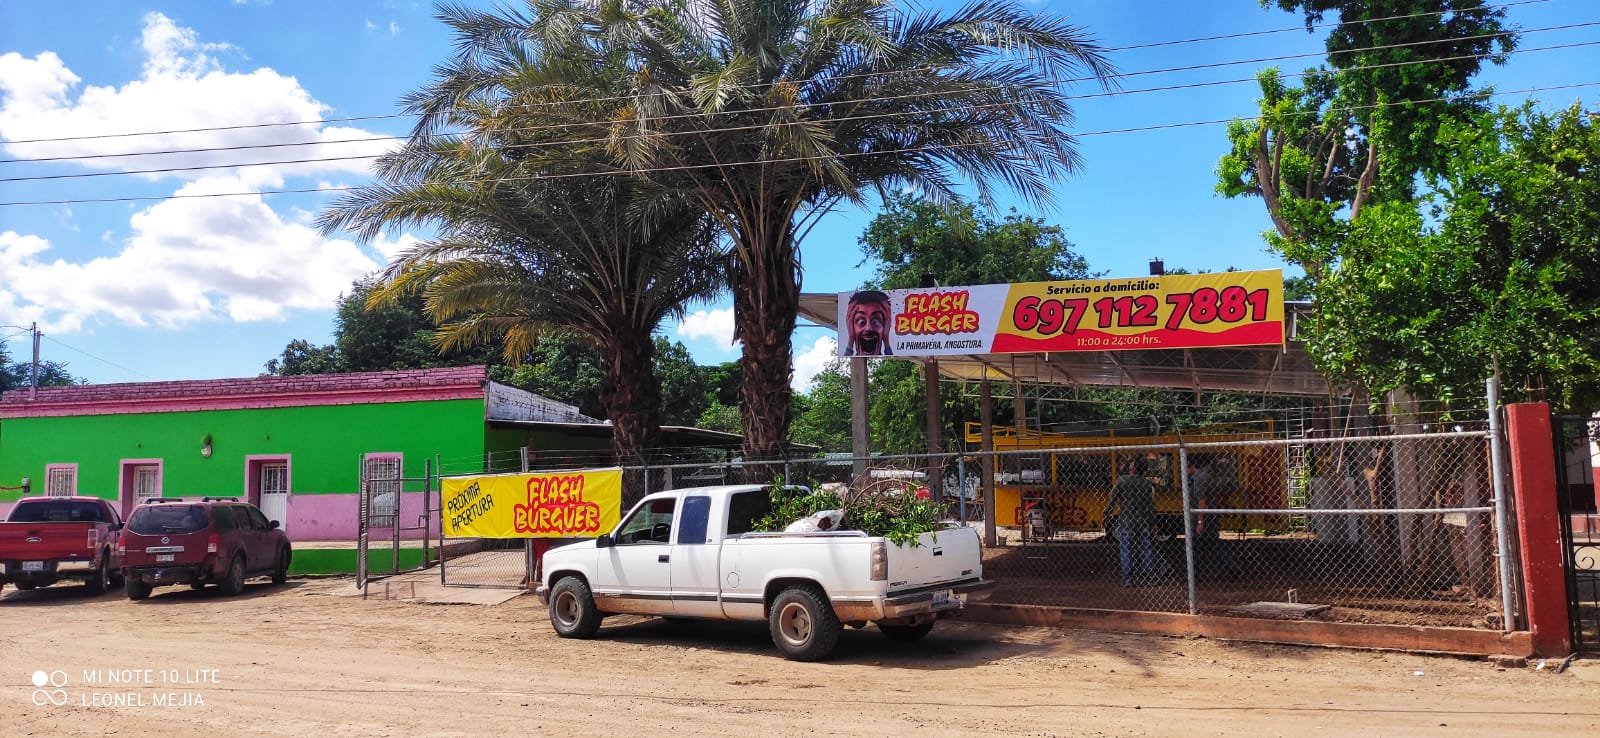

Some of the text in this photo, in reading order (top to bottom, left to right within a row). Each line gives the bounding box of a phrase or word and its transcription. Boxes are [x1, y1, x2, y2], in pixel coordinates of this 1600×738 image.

[1047, 280, 1160, 295] Servicio a domicilio:
[905, 291, 968, 314] FLASH
[1013, 286, 1269, 335] 697 112 7881
[896, 311, 979, 335] BURGER
[897, 341, 905, 350] LA
[1077, 338, 1101, 346] 11:00
[1111, 336, 1140, 346] 24:00
[1142, 333, 1161, 345] hrs.
[448, 482, 481, 515] PRÓXIMA
[528, 475, 584, 504] FLASH
[452, 494, 494, 533] APERTURA
